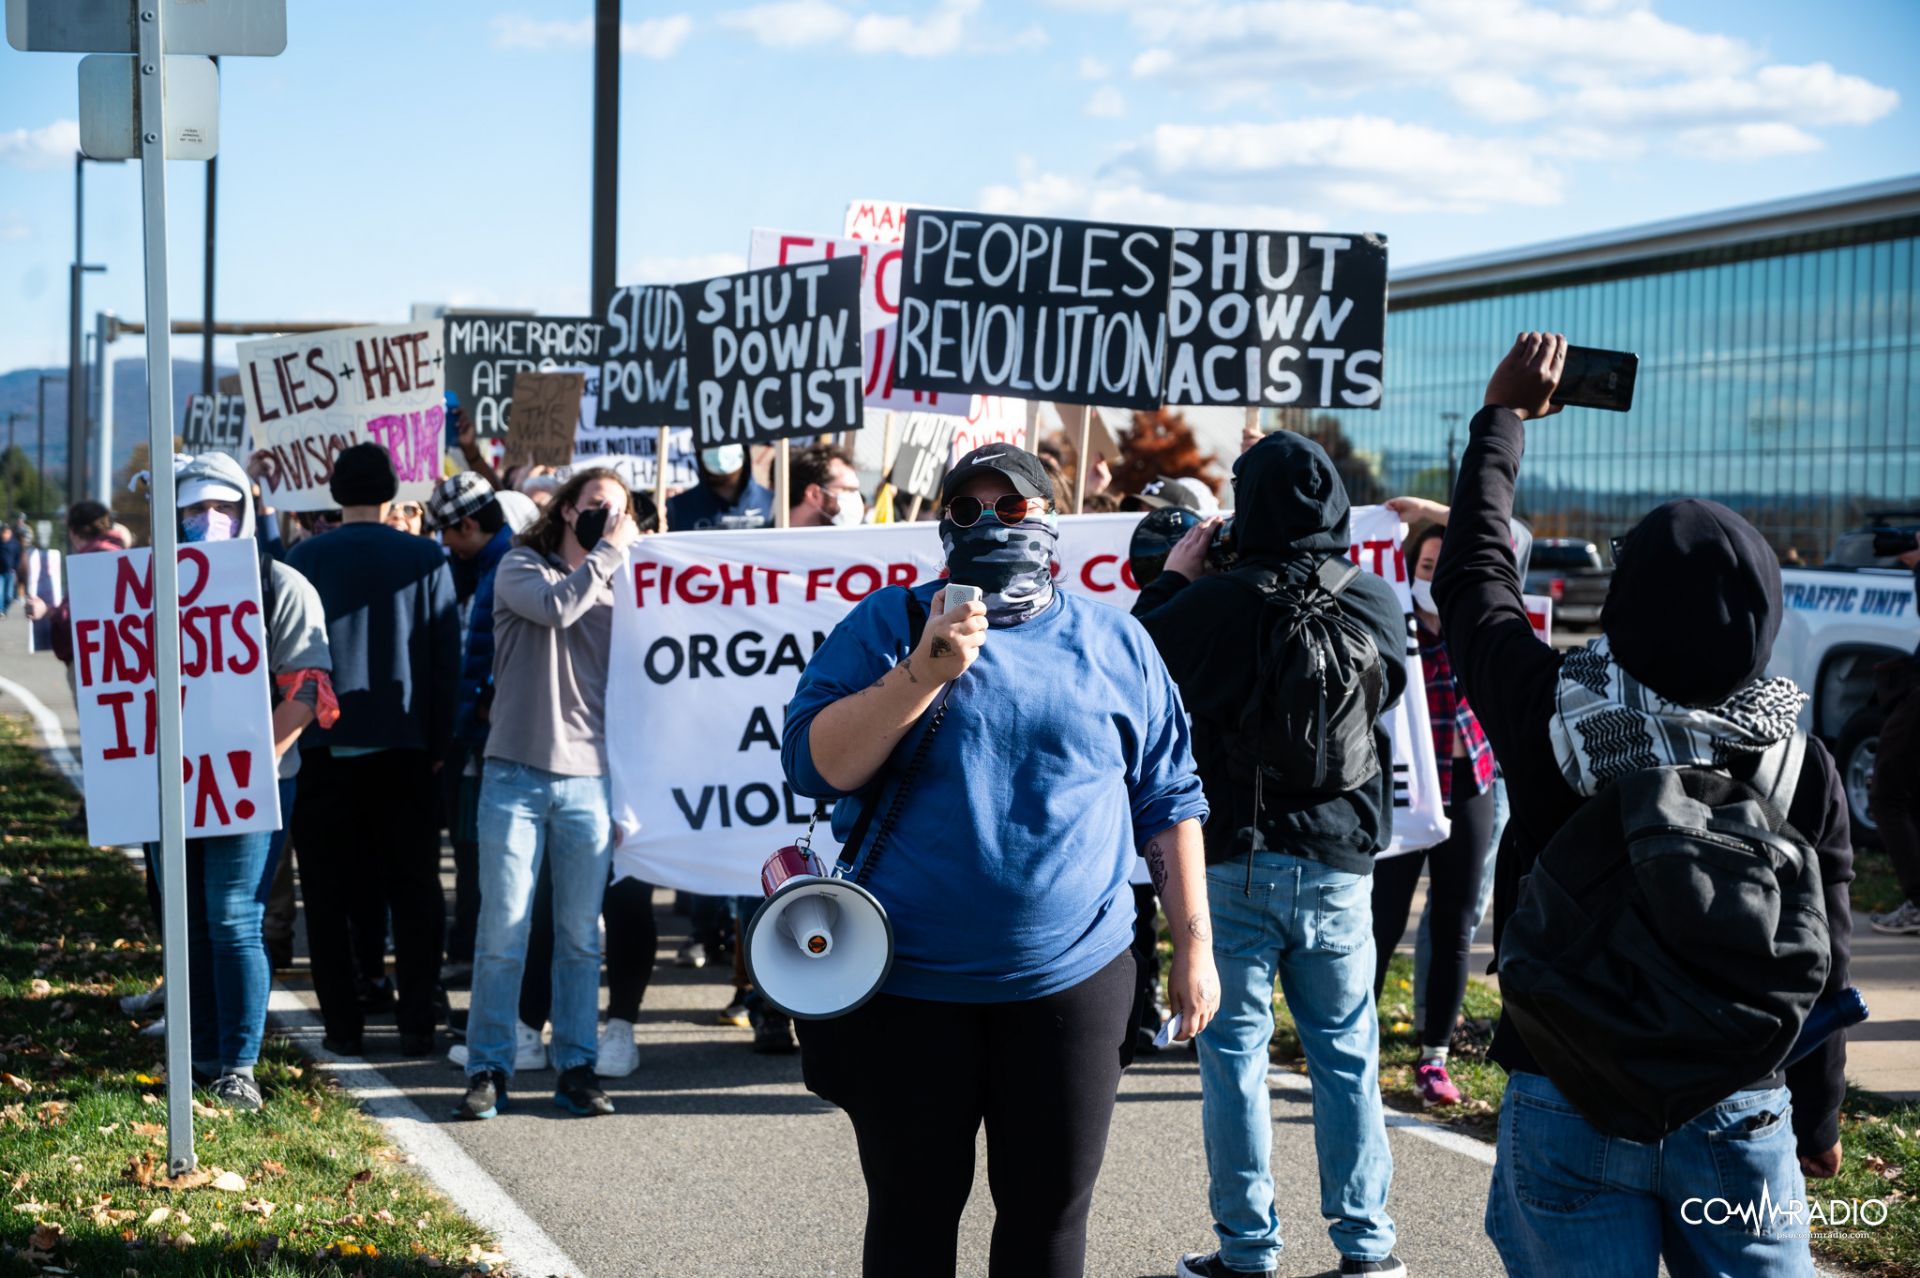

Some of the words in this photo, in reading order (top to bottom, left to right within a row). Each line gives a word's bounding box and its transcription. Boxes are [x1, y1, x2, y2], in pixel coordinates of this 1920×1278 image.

[914, 215, 1160, 298] PEOPLES
[1171, 229, 1352, 291] SHUT
[607, 286, 688, 358] STUD
[696, 263, 829, 330] SHUT
[1168, 288, 1354, 342] DOWN
[249, 347, 338, 423] LIES
[356, 331, 435, 401] HATE
[712, 308, 849, 379] DOWN
[898, 297, 1166, 398] REVOLUTION
[1163, 342, 1383, 408] ACISTS
[188, 393, 244, 444] FREE
[698, 366, 862, 444] RACIST
[114, 546, 210, 615] NO
[634, 561, 790, 609] FIGHT
[805, 562, 918, 602] FOR
[1783, 583, 1859, 613] TRAFFIC
[1859, 587, 1913, 618] UNIT
[182, 749, 256, 828] A!
[671, 781, 836, 831] VIOL
